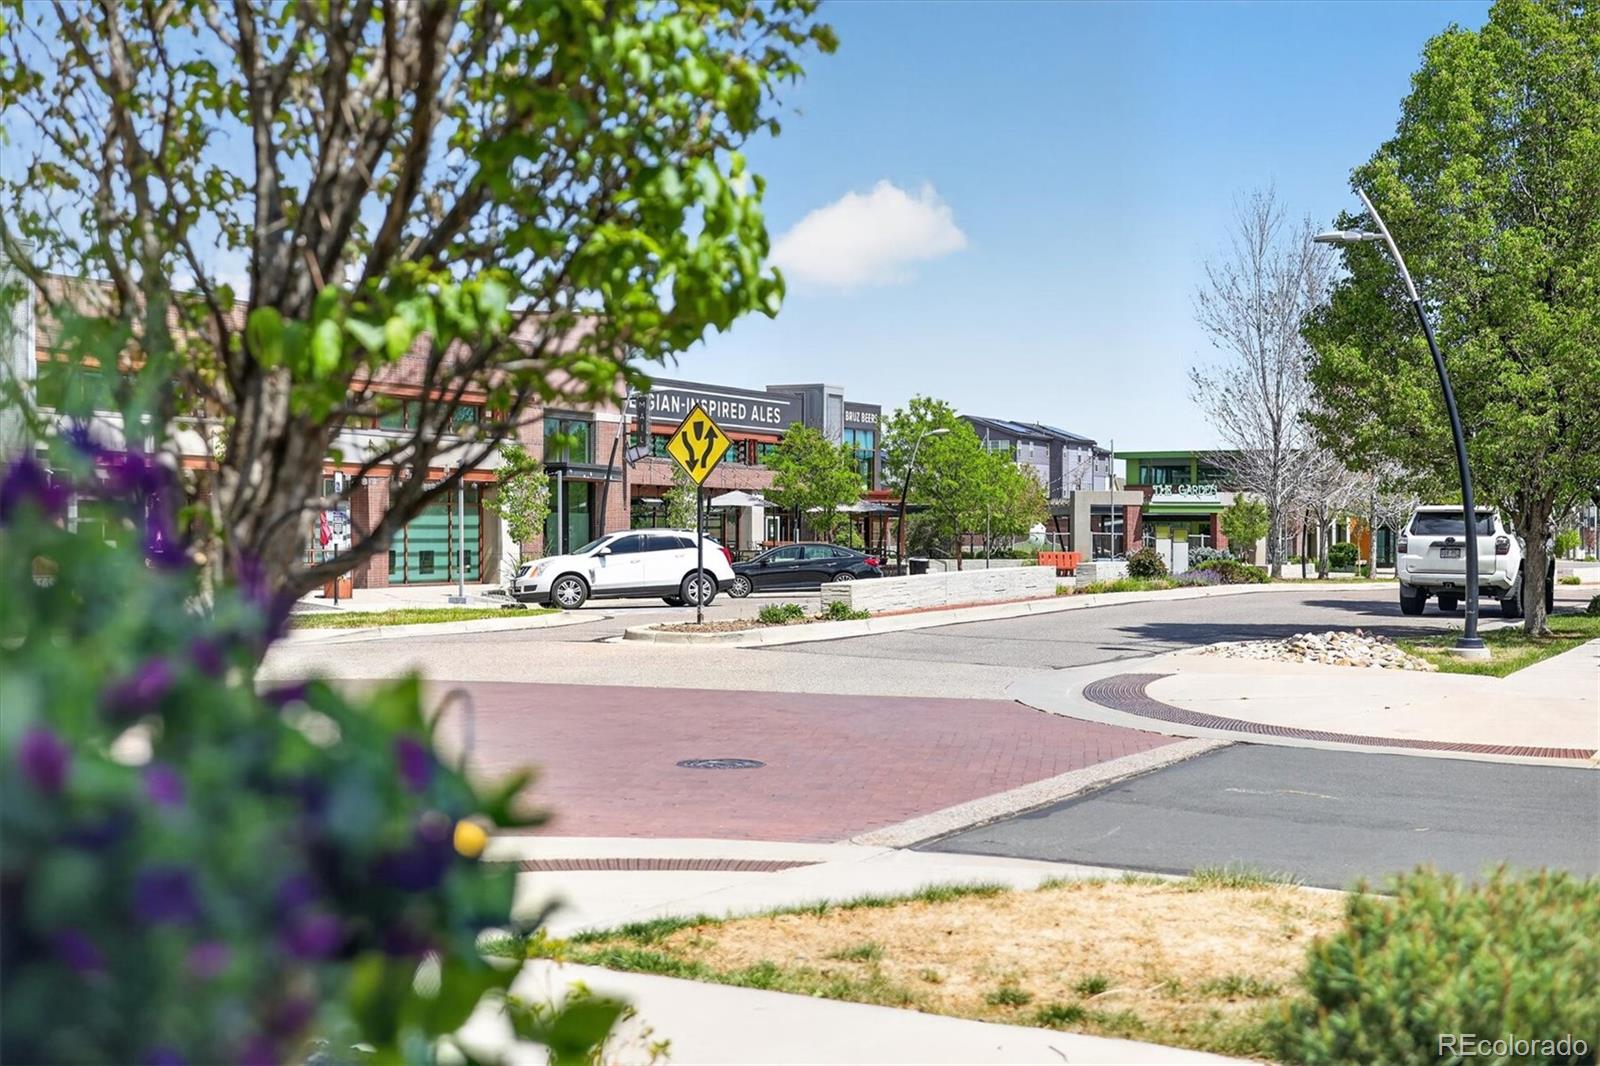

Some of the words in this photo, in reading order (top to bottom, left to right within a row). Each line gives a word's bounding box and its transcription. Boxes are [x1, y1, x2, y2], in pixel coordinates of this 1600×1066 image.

[751, 405, 781, 424] ALES
[861, 412, 878, 424] BEERS
[1152, 484, 1172, 496] THE
